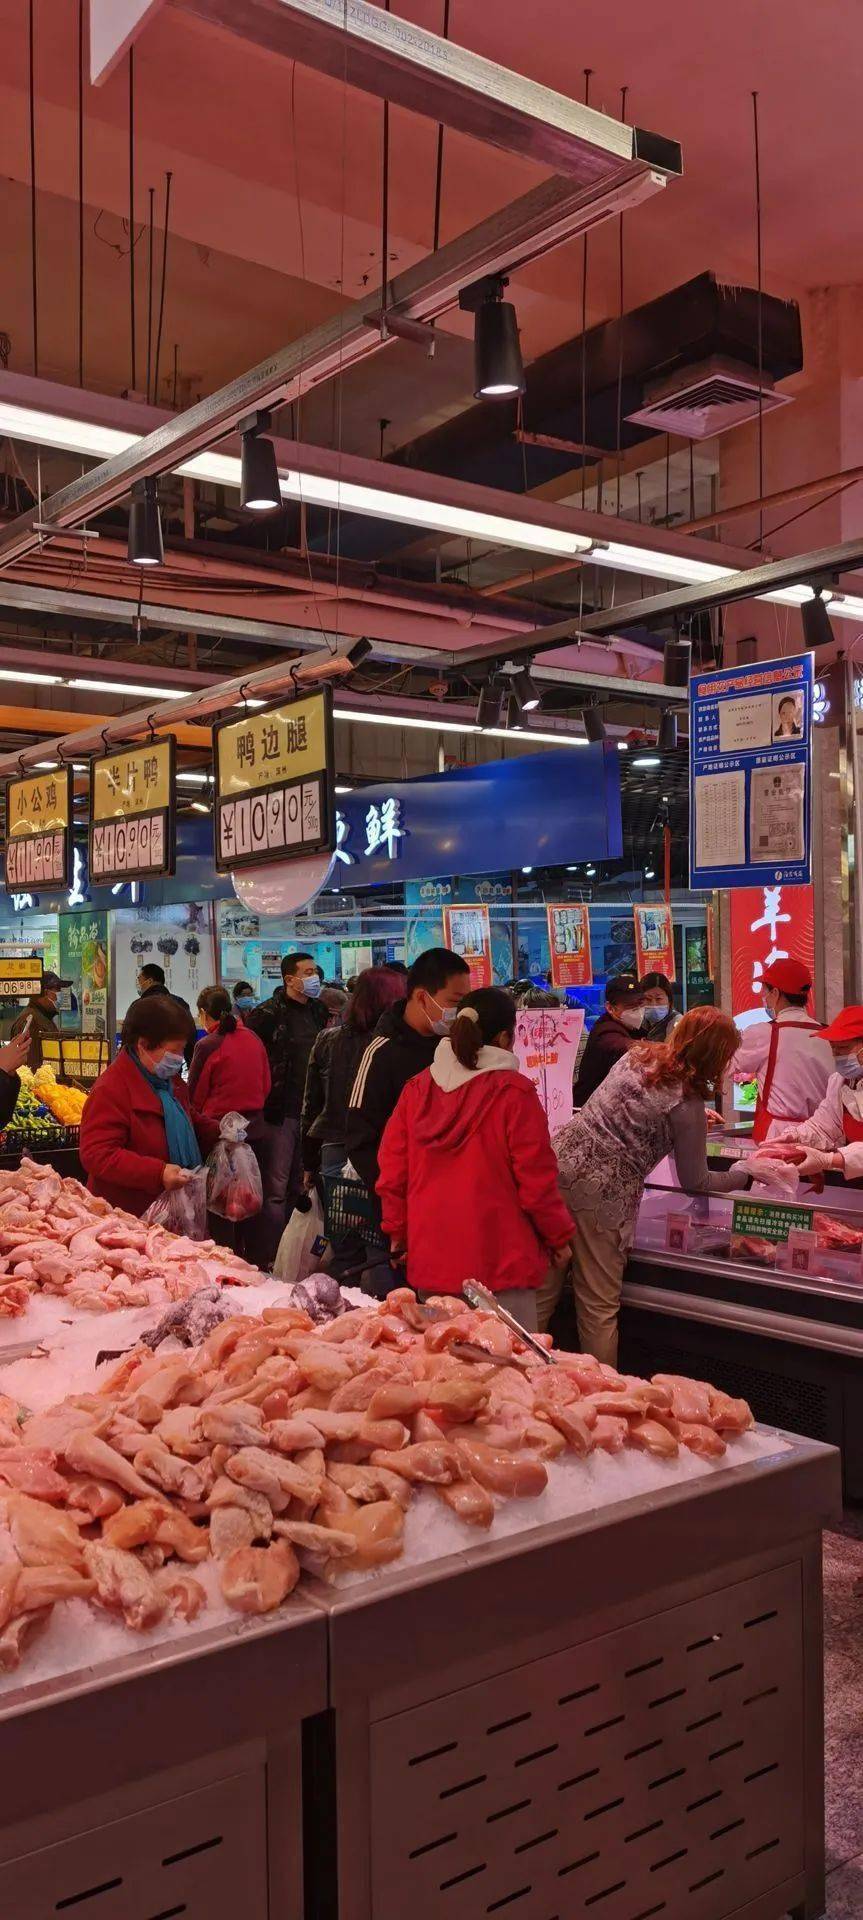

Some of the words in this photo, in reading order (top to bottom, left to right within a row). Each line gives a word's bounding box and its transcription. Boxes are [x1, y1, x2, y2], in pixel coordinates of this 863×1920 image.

[236, 715, 308, 769] 鸭边腿
[107, 755, 158, 797] 半片鸭
[17, 781, 57, 816] 小公鸡
